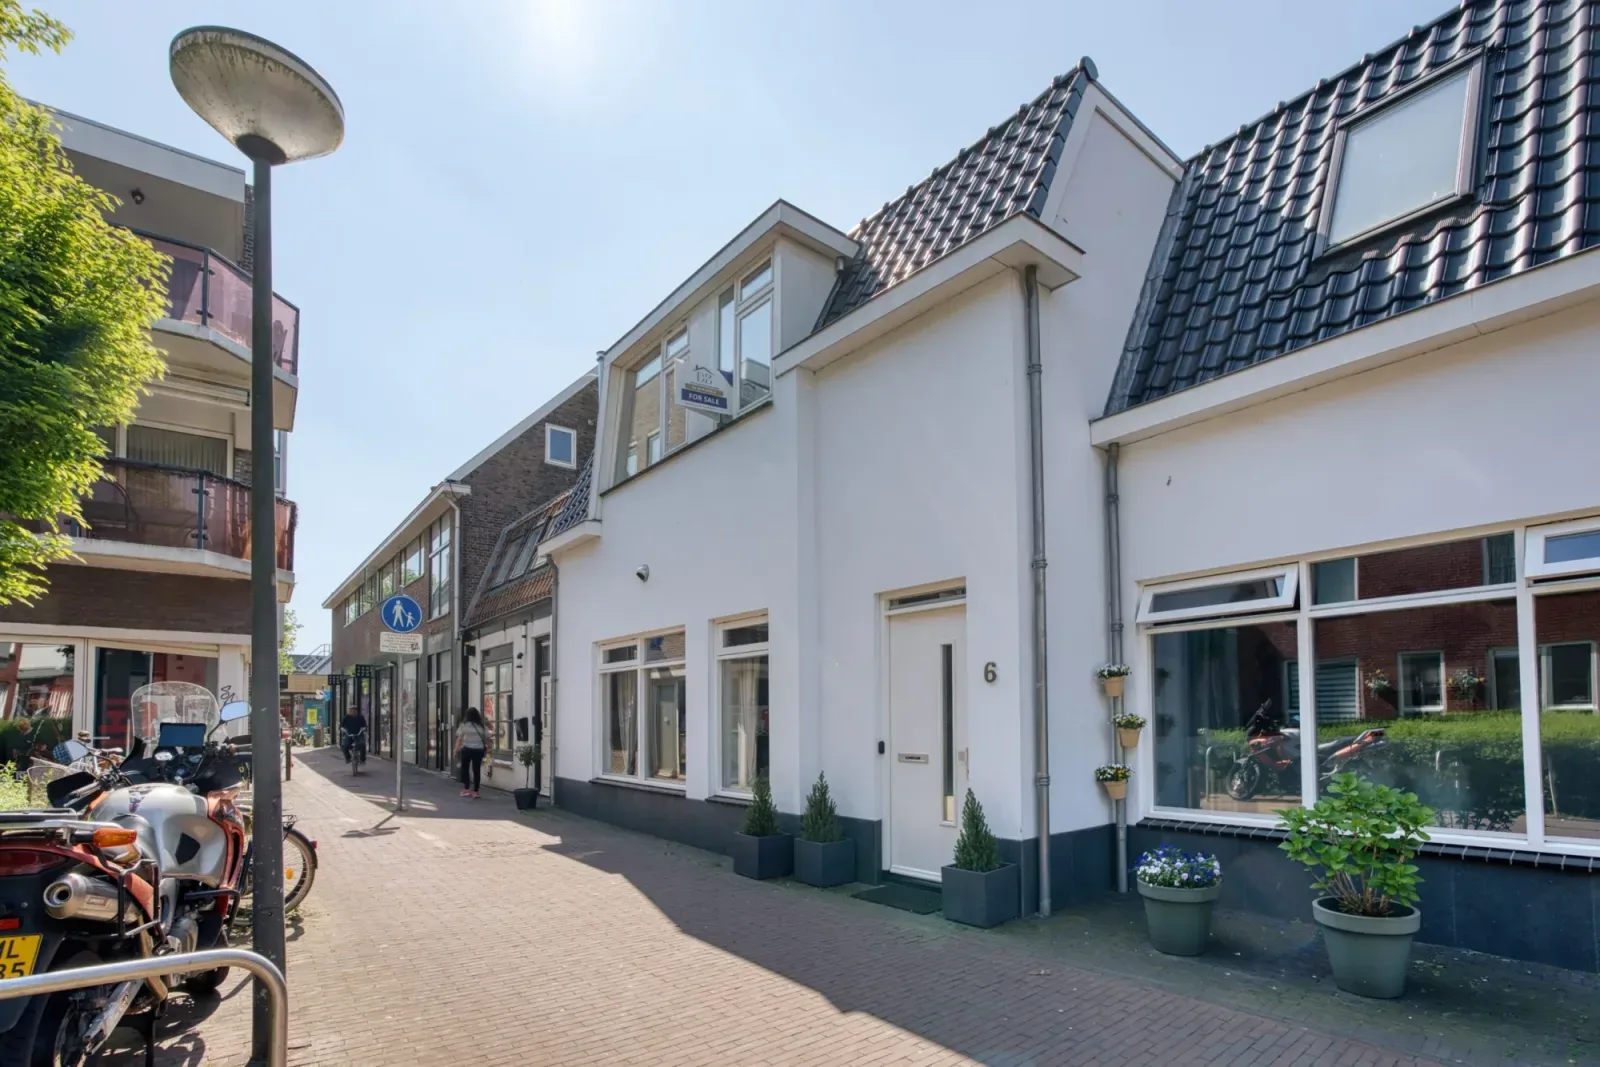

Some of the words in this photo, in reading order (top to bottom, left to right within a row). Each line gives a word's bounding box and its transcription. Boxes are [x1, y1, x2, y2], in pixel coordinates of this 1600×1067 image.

[688, 392, 703, 402] FOR
[703, 396, 720, 406] SALE
[984, 661, 997, 683] 6
